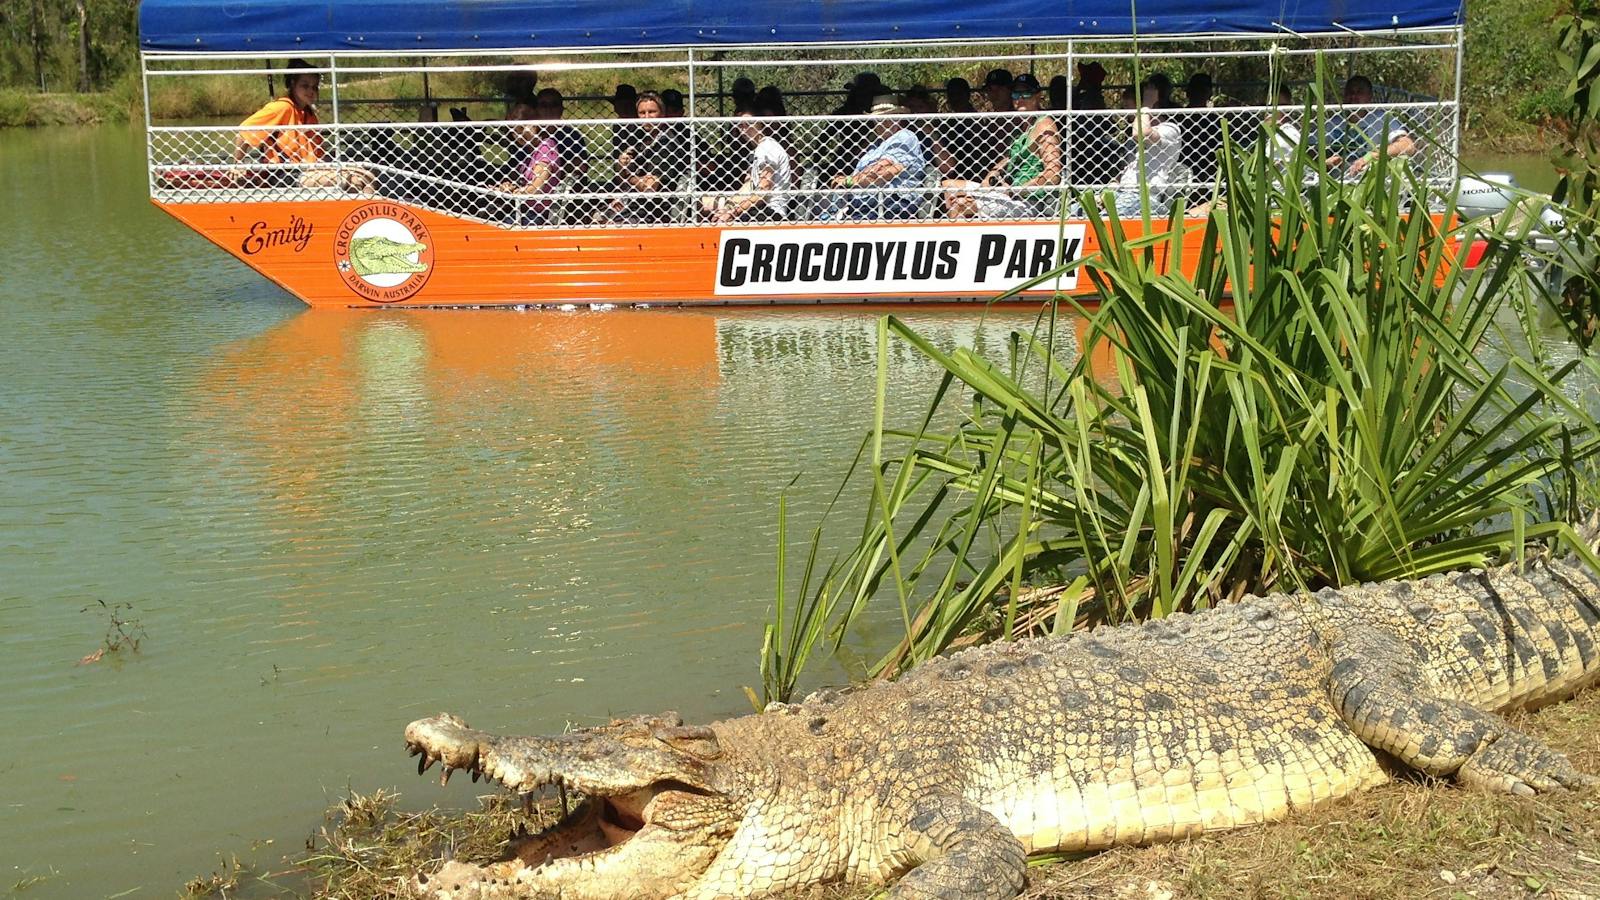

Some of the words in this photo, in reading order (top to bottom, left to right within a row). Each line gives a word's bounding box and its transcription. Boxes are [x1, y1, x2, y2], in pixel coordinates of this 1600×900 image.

[1462, 187, 1502, 196] HONDA
[241, 216, 314, 255] Emily
[336, 205, 398, 257] CROCODYLUS
[400, 211, 428, 241] PARK
[719, 237, 961, 288] CROCODYLUS
[973, 233, 1081, 283] PARK
[348, 274, 380, 299] DARWIN
[383, 273, 425, 299] AUSTRALIA
